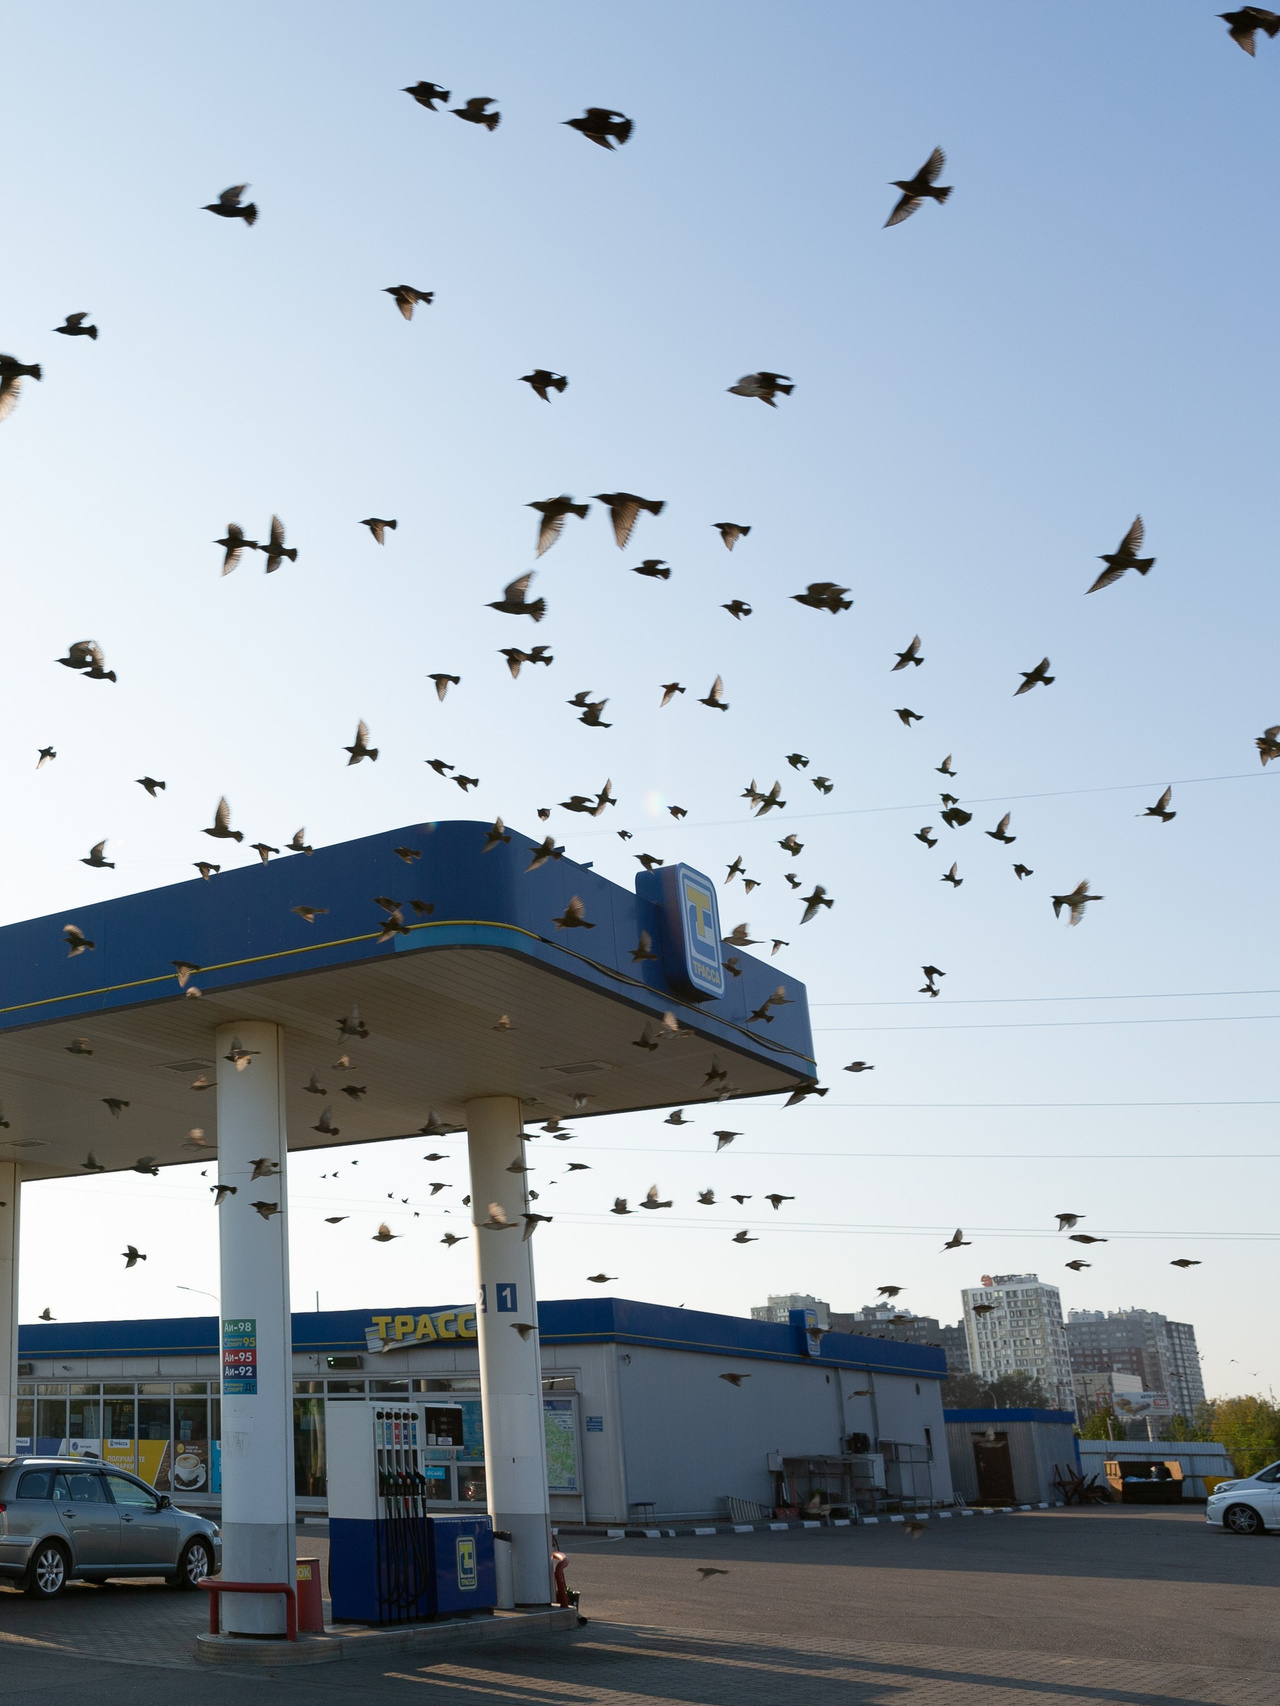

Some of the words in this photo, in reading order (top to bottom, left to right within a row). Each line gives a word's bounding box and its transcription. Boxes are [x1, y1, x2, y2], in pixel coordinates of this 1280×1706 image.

[693, 960, 720, 985] ТРАССА
[502, 1287, 512, 1308] 1
[224, 1322, 252, 1332] Аи-98
[372, 1313, 476, 1340] ТРАСС
[242, 1337, 256, 1347] 95
[224, 1352, 253, 1362] Аи-95
[224, 1366, 253, 1376] Аи-92
